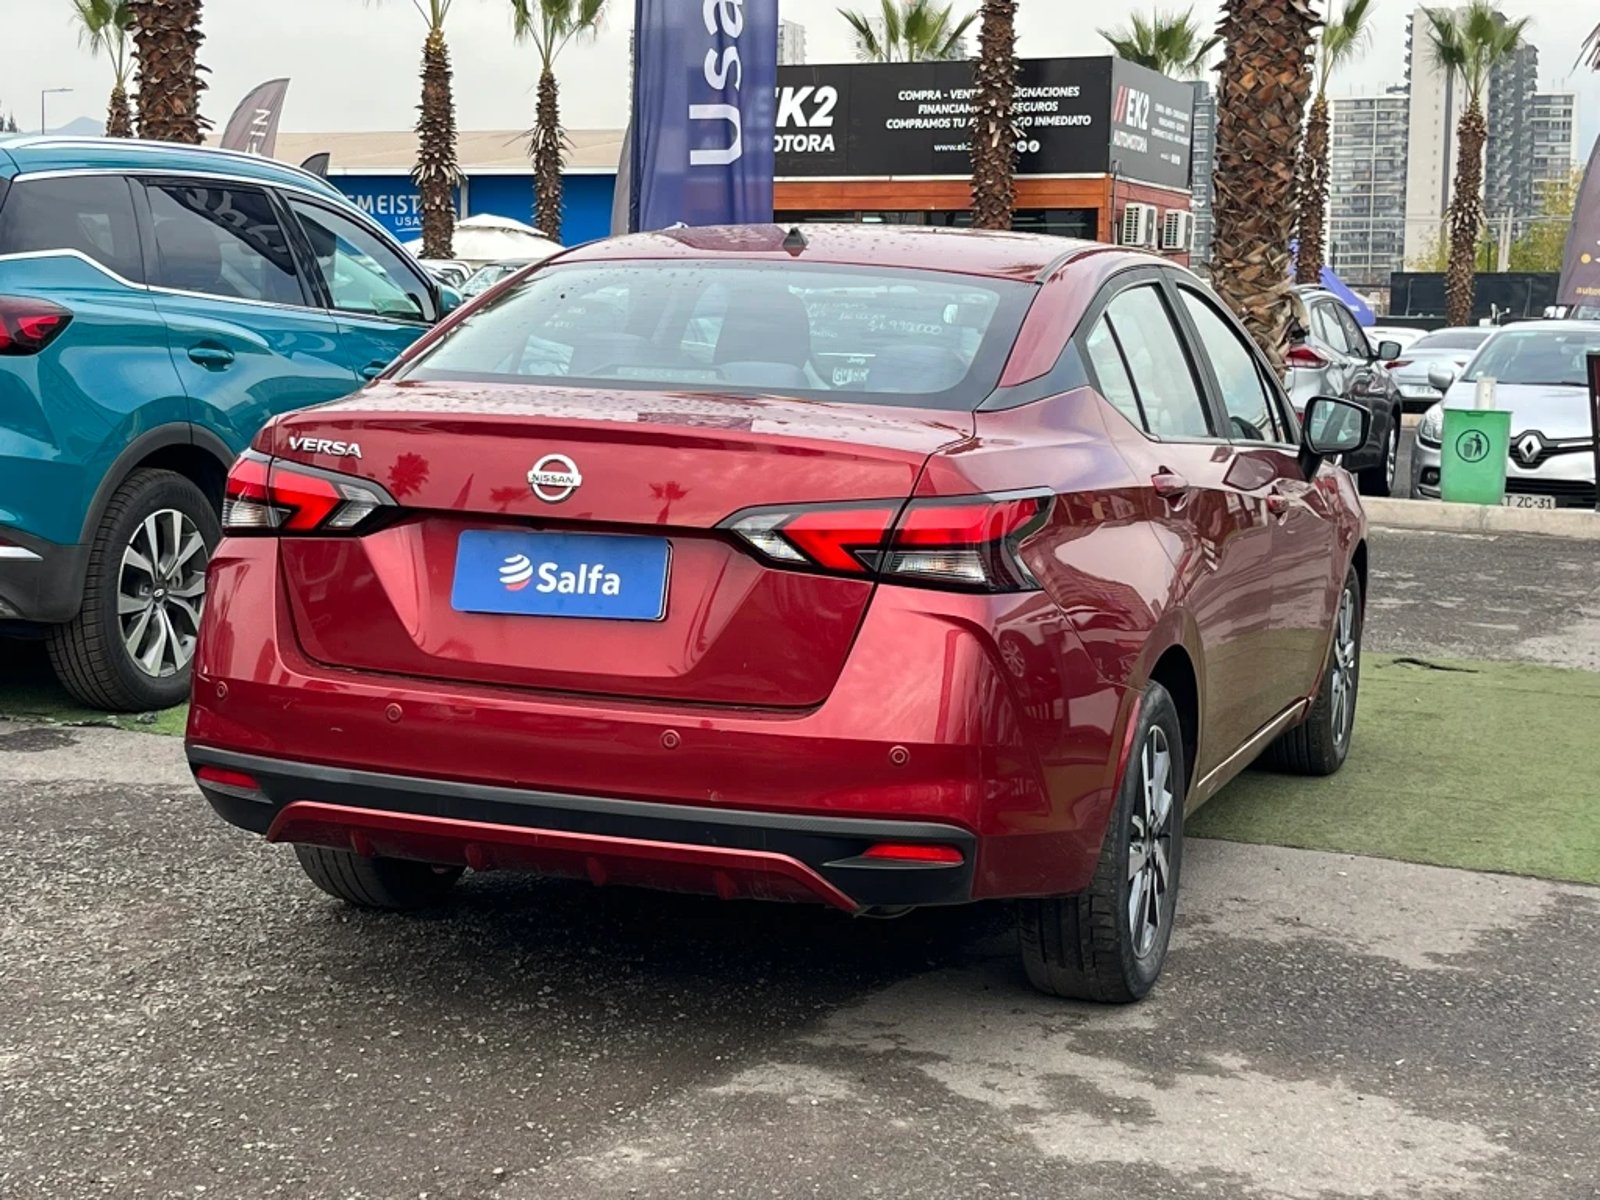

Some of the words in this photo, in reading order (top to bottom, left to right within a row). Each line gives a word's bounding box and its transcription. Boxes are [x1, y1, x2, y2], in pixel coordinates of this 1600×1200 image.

[688, 0, 743, 166] Usa
[898, 90, 942, 101] COMPRA
[950, 88, 978, 100] VENT
[774, 86, 839, 128] K2
[1125, 87, 1150, 131] EK2
[885, 117, 951, 129] COMPRAMOS
[952, 117, 967, 128] TU
[1034, 115, 1092, 126] INMEDIATO
[773, 134, 836, 152] OTORA
[289, 436, 363, 459] VERSA
[531, 473, 575, 484] NISSAN
[535, 561, 620, 596] Salfa
